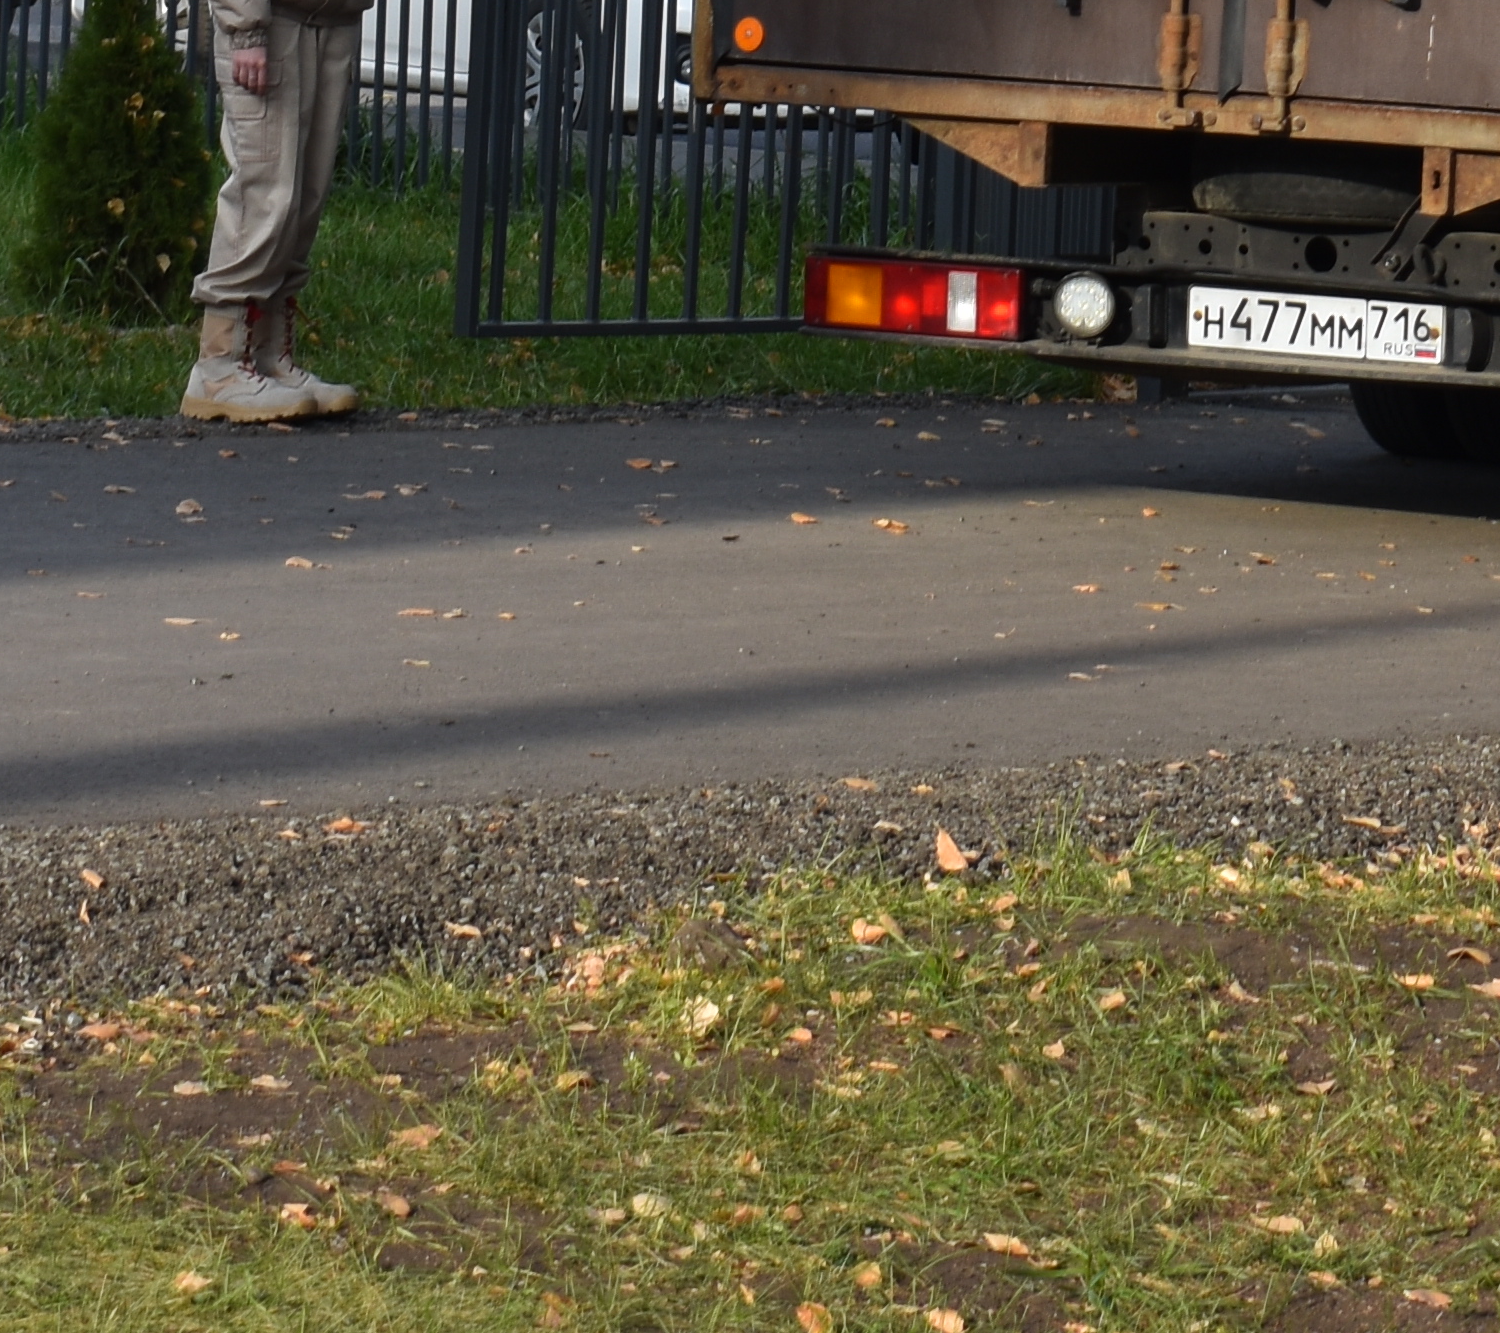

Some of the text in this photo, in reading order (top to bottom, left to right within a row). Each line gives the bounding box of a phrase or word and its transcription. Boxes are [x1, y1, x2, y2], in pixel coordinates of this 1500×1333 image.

[1203, 297, 1431, 351] Н477ММ 716
[1383, 342, 1413, 356] RUS
